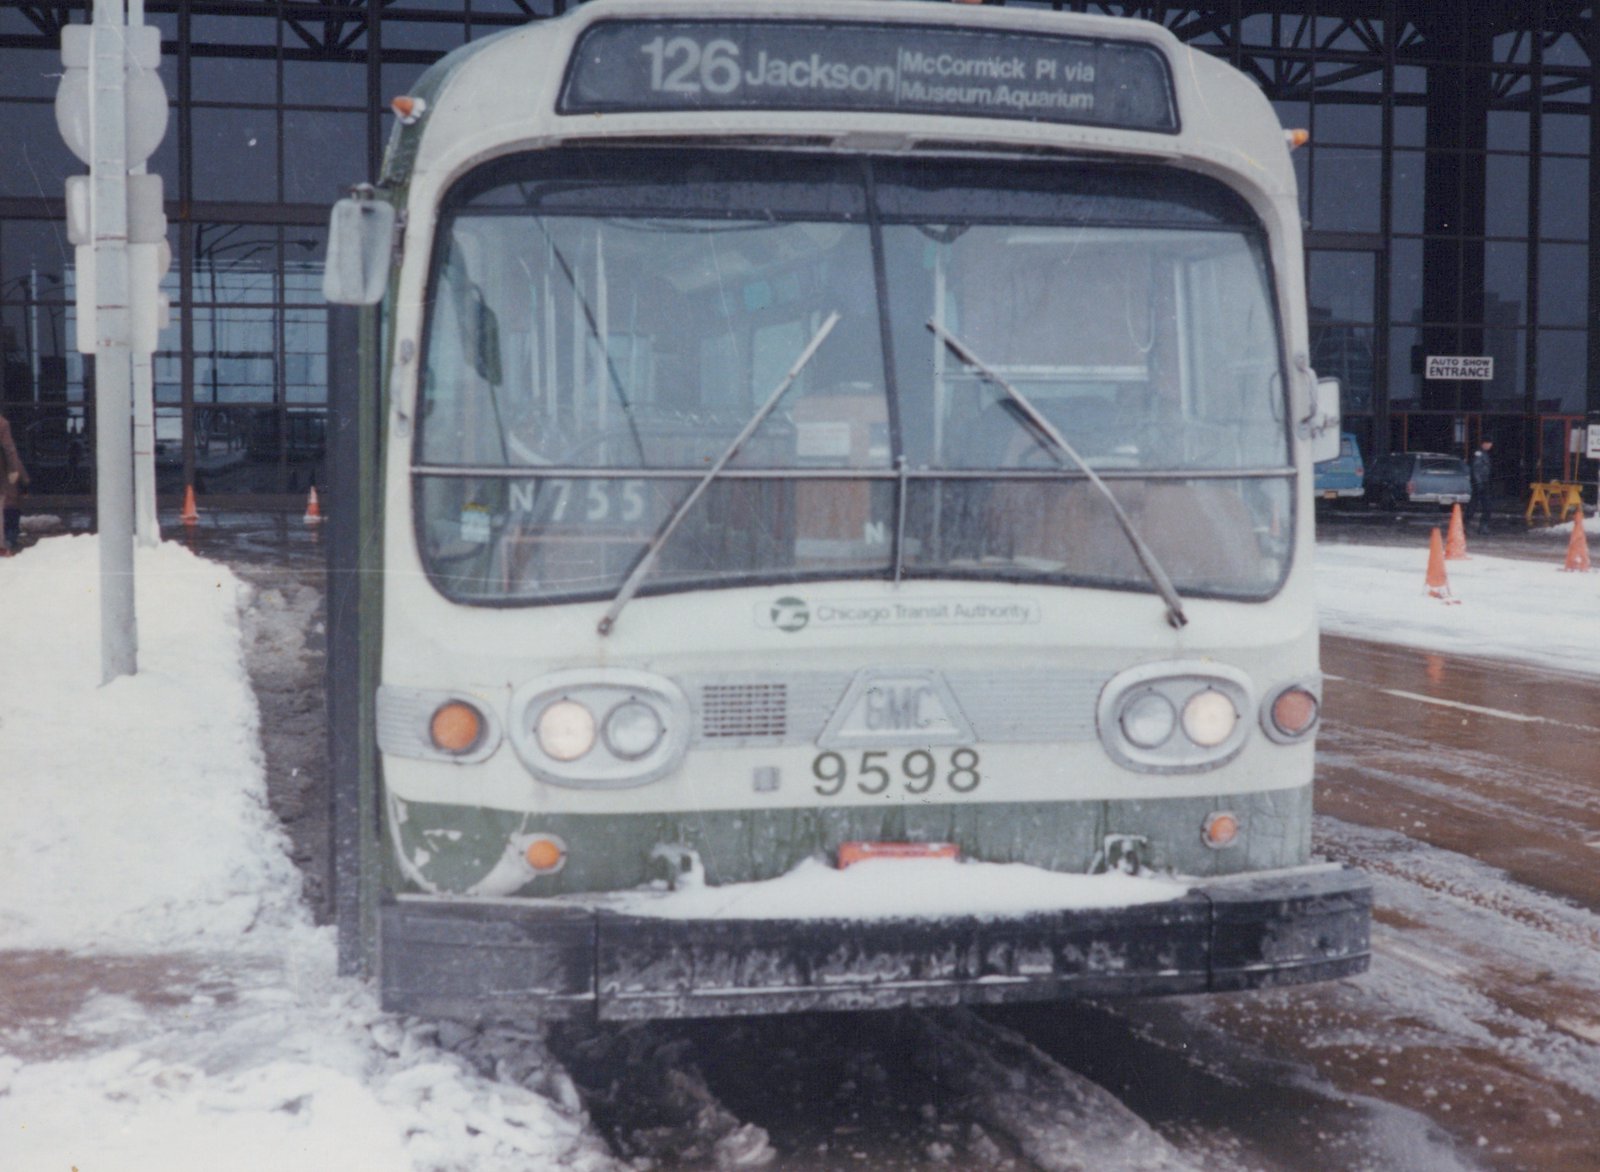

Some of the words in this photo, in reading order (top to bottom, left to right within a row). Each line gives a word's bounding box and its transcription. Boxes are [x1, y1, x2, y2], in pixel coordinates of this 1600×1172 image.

[641, 36, 740, 93] 126
[745, 51, 894, 91] Jackson
[903, 50, 1025, 79] McCormick
[1036, 59, 1056, 80] Pl
[1065, 61, 1094, 82] via
[1429, 367, 1490, 377] ENTRANCE
[1463, 358, 1490, 366] SHOW
[817, 605, 889, 623] Chicago
[893, 604, 948, 618] Transit
[954, 602, 1030, 619] Authority
[812, 747, 980, 797] 9598
